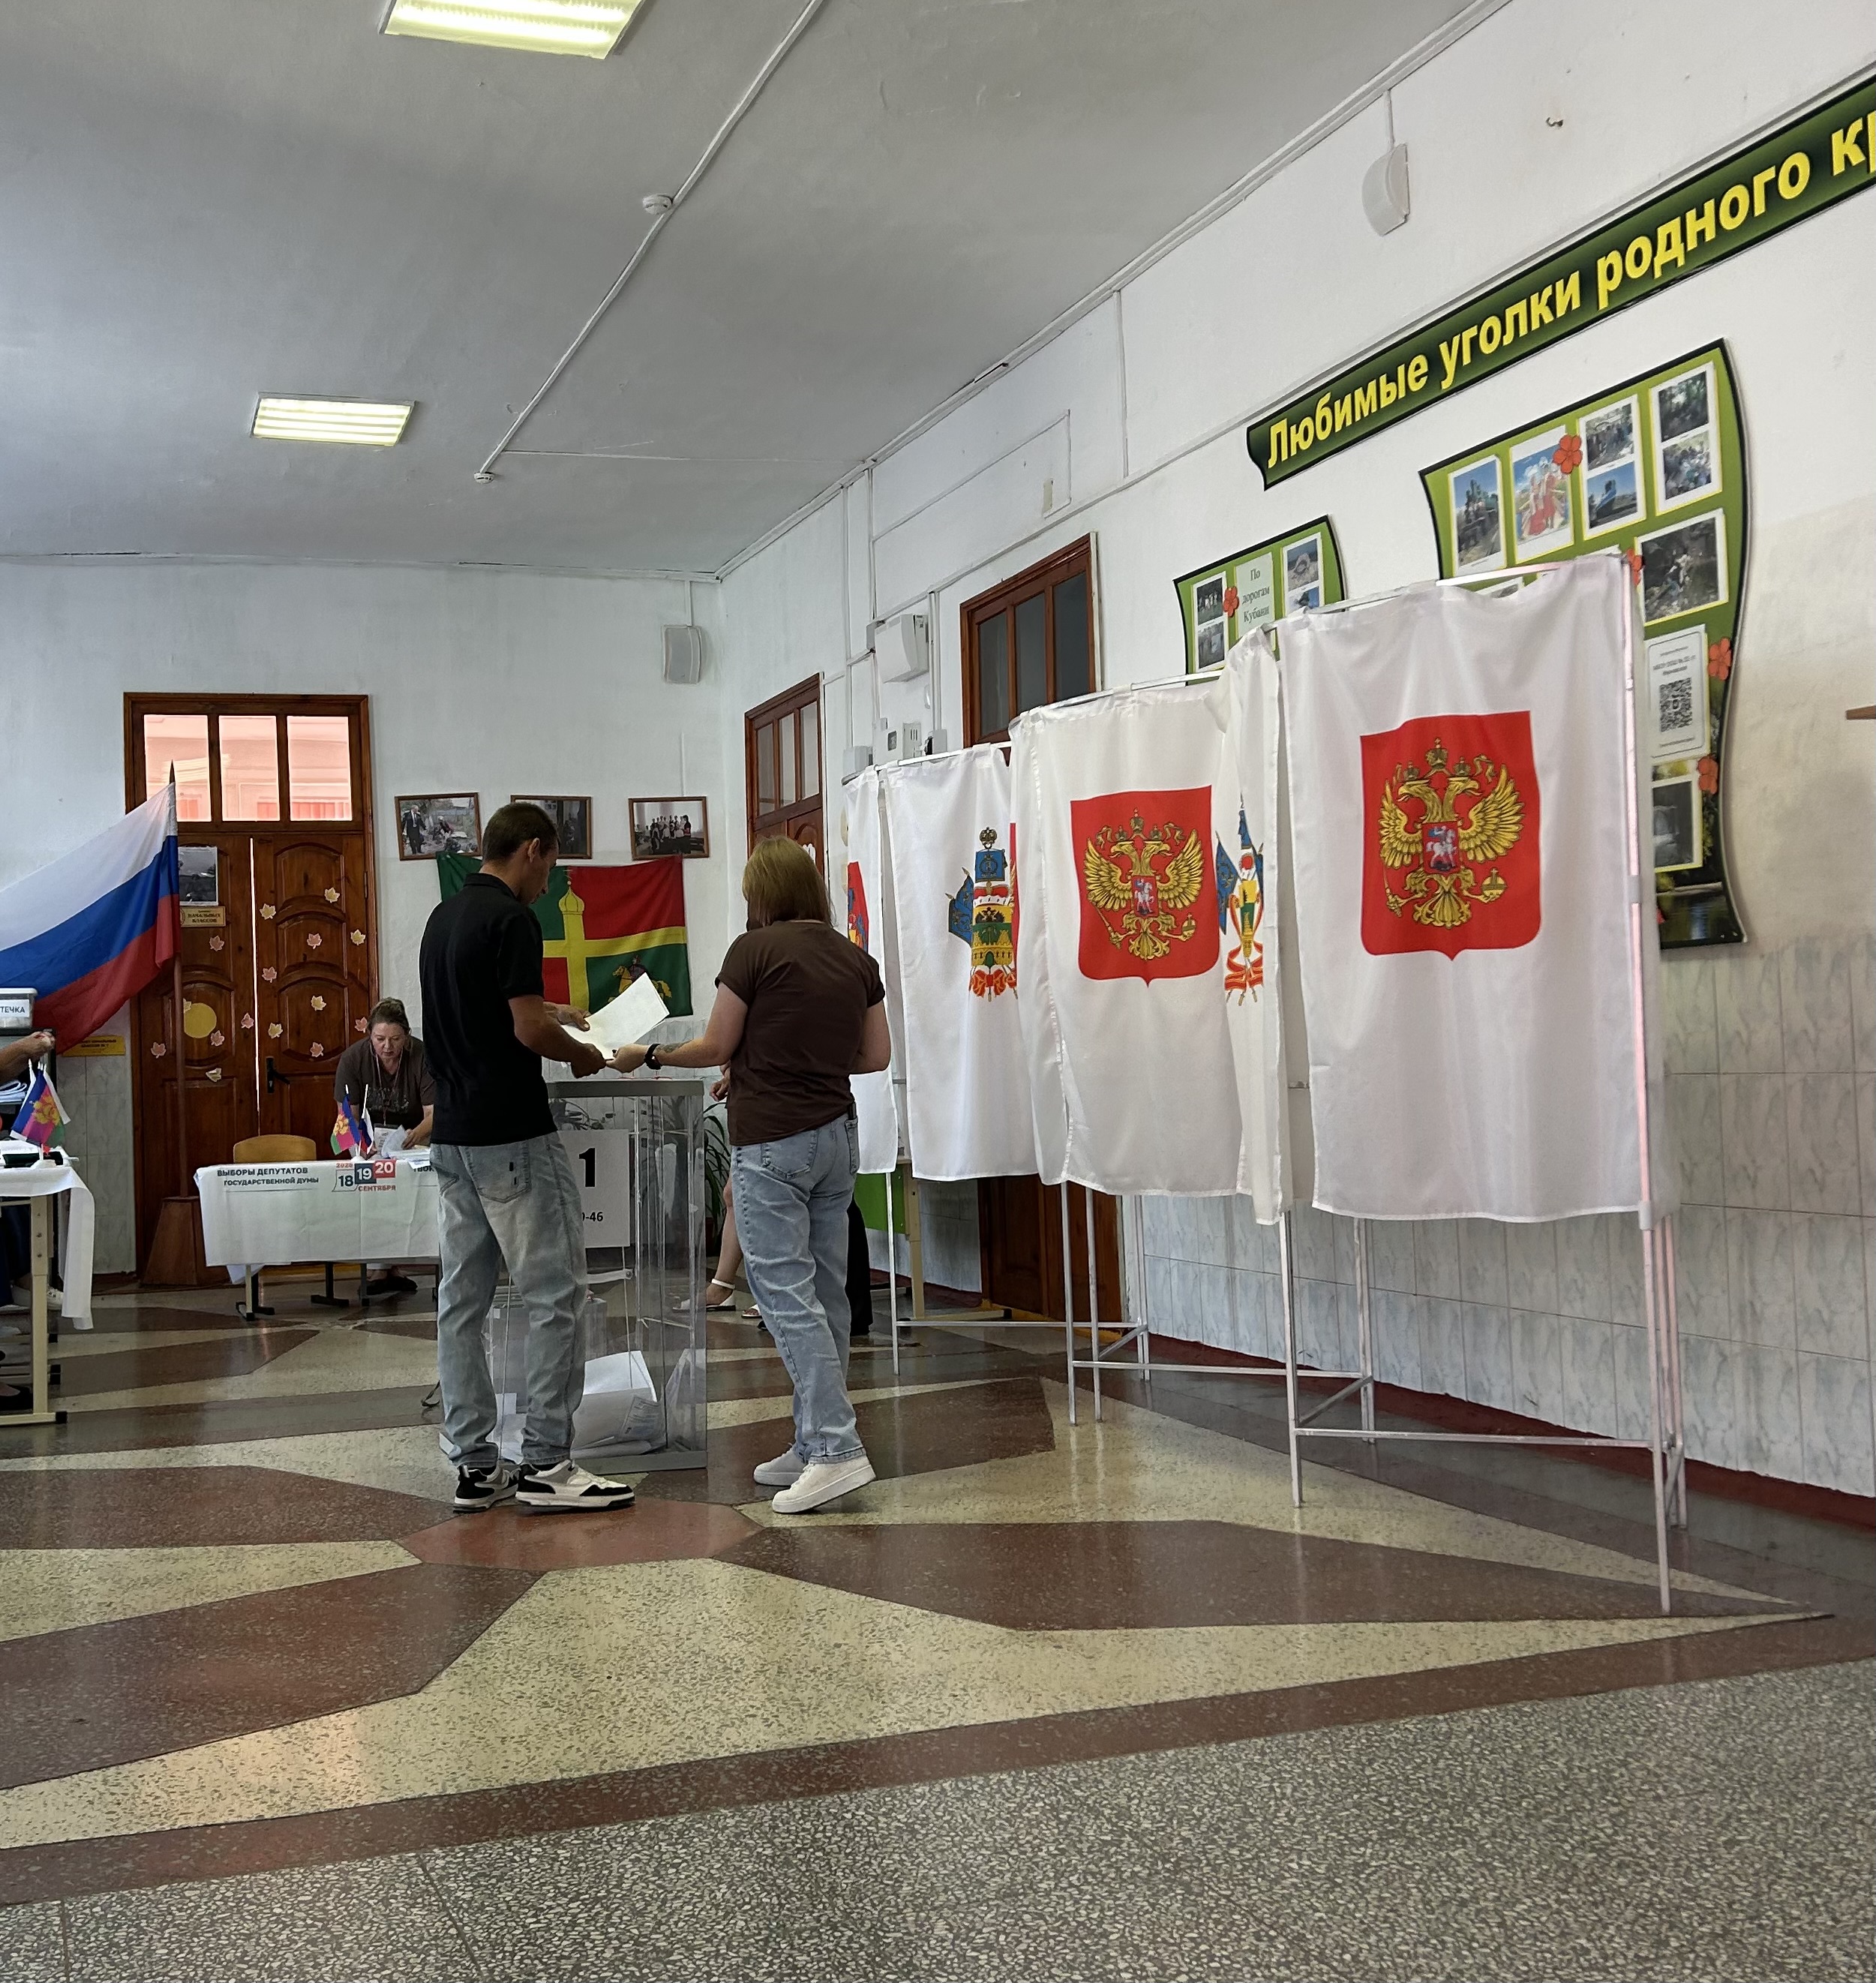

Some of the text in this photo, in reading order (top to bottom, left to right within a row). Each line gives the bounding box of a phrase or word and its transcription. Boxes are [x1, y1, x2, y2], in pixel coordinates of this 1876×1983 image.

[1268, 354, 1429, 469] Любимые
[1439, 270, 1580, 390] уголки
[1597, 152, 1811, 311] родного
[1250, 568, 1261, 581] По
[1242, 586, 1270, 605] дорогам
[1243, 605, 1270, 624] Кубани
[217, 1167, 308, 1177] ВЫБОРЫ ДЕПУТАТОВ
[356, 1167, 372, 1180] 19
[375, 1161, 394, 1173] 20
[224, 1176, 296, 1186] ГОСУДАРСТВЕННОЙ
[338, 1175, 354, 1187] 18
